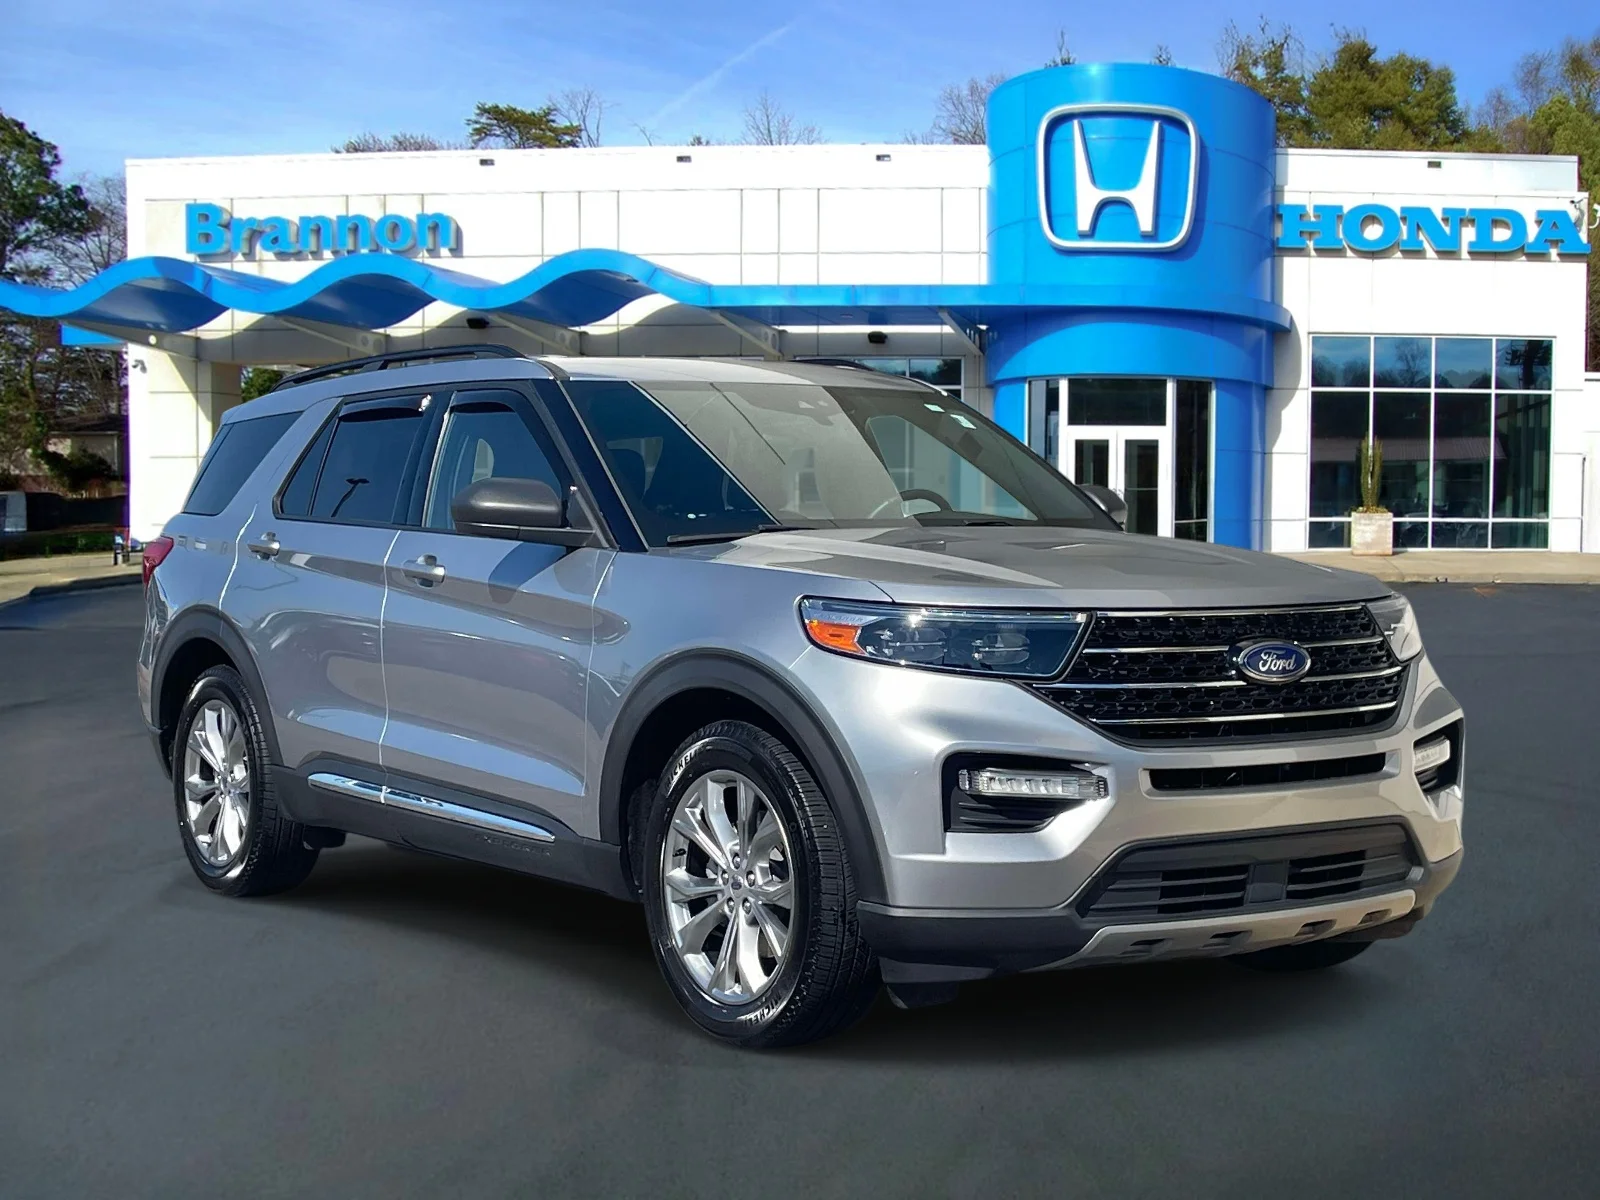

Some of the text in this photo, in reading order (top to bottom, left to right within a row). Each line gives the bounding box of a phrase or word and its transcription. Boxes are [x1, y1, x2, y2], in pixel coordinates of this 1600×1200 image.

[184, 202, 457, 256] Brannon
[1276, 203, 1591, 254] HONDA
[1258, 648, 1296, 672] Ford
[665, 744, 707, 790] MICHELI
[738, 991, 783, 1026] MICHELI
